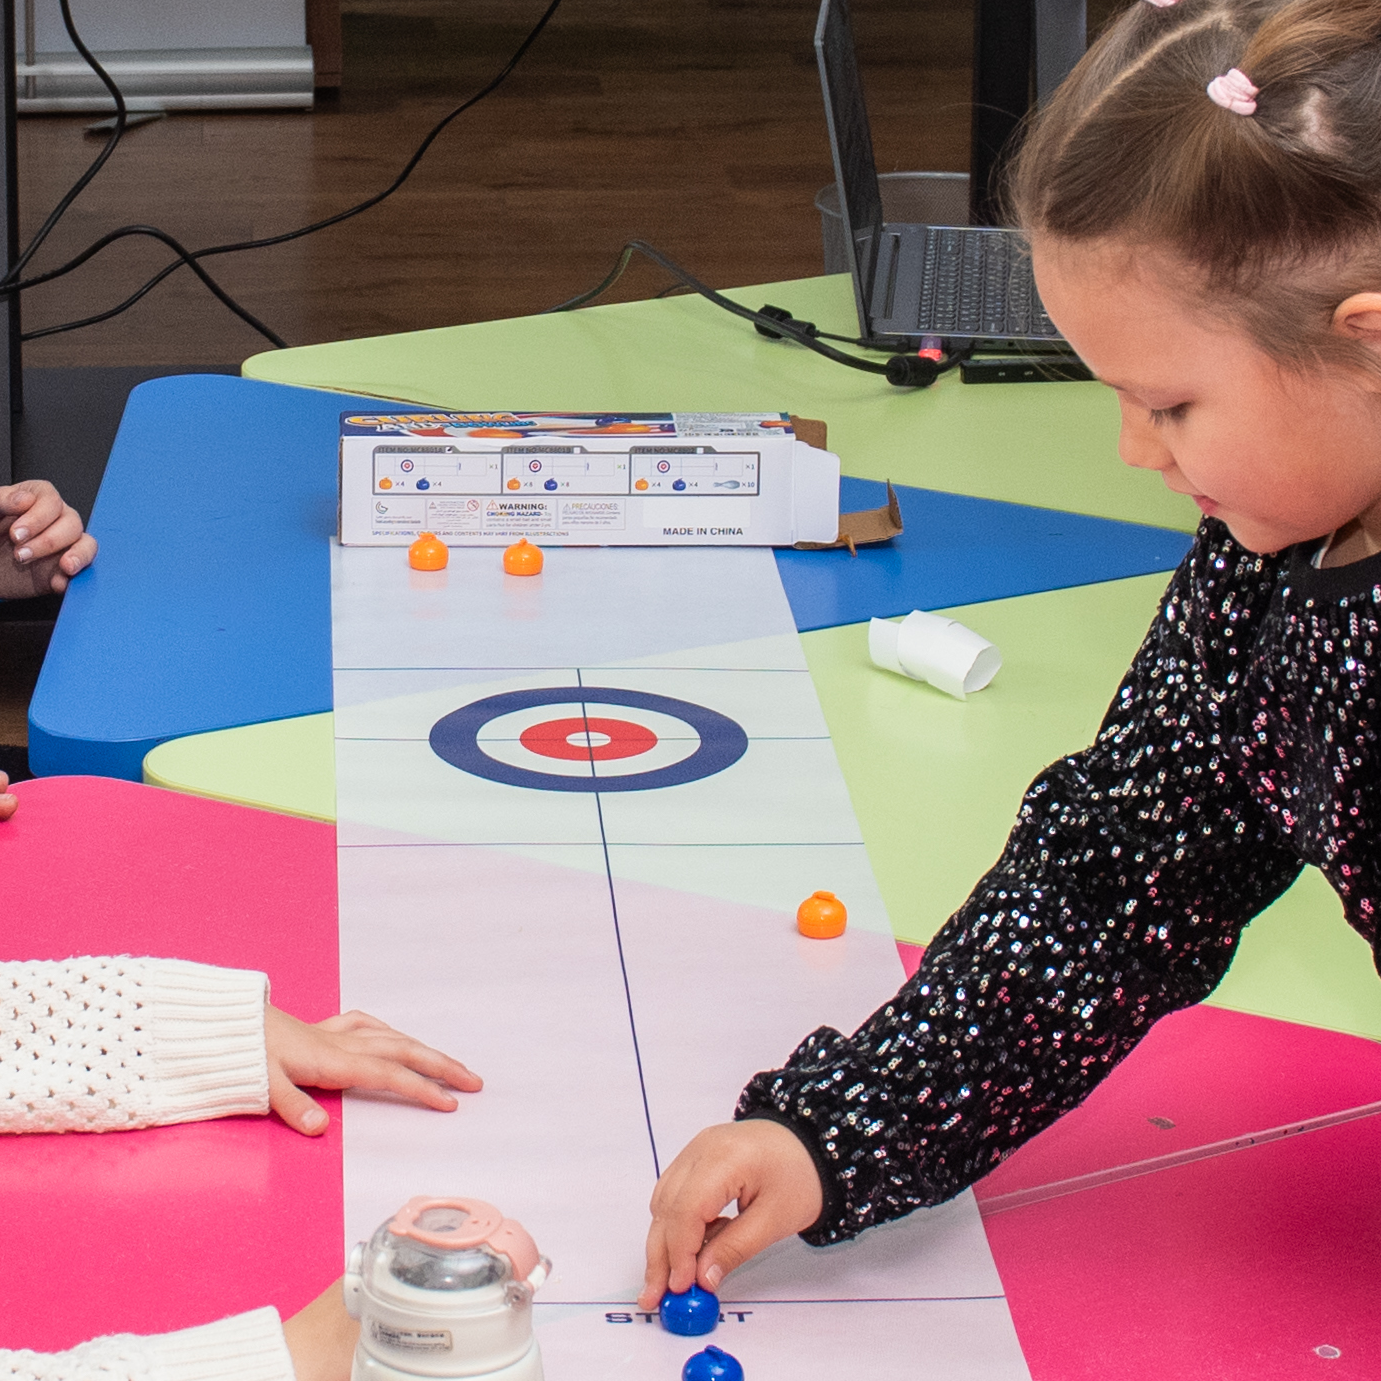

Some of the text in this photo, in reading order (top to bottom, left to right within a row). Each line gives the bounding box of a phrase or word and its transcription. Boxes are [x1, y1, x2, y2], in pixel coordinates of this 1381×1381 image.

[499, 503, 548, 511] WARNING:
[663, 527, 743, 536] MADE IN CHINA
[605, 1311, 753, 1324] STT
